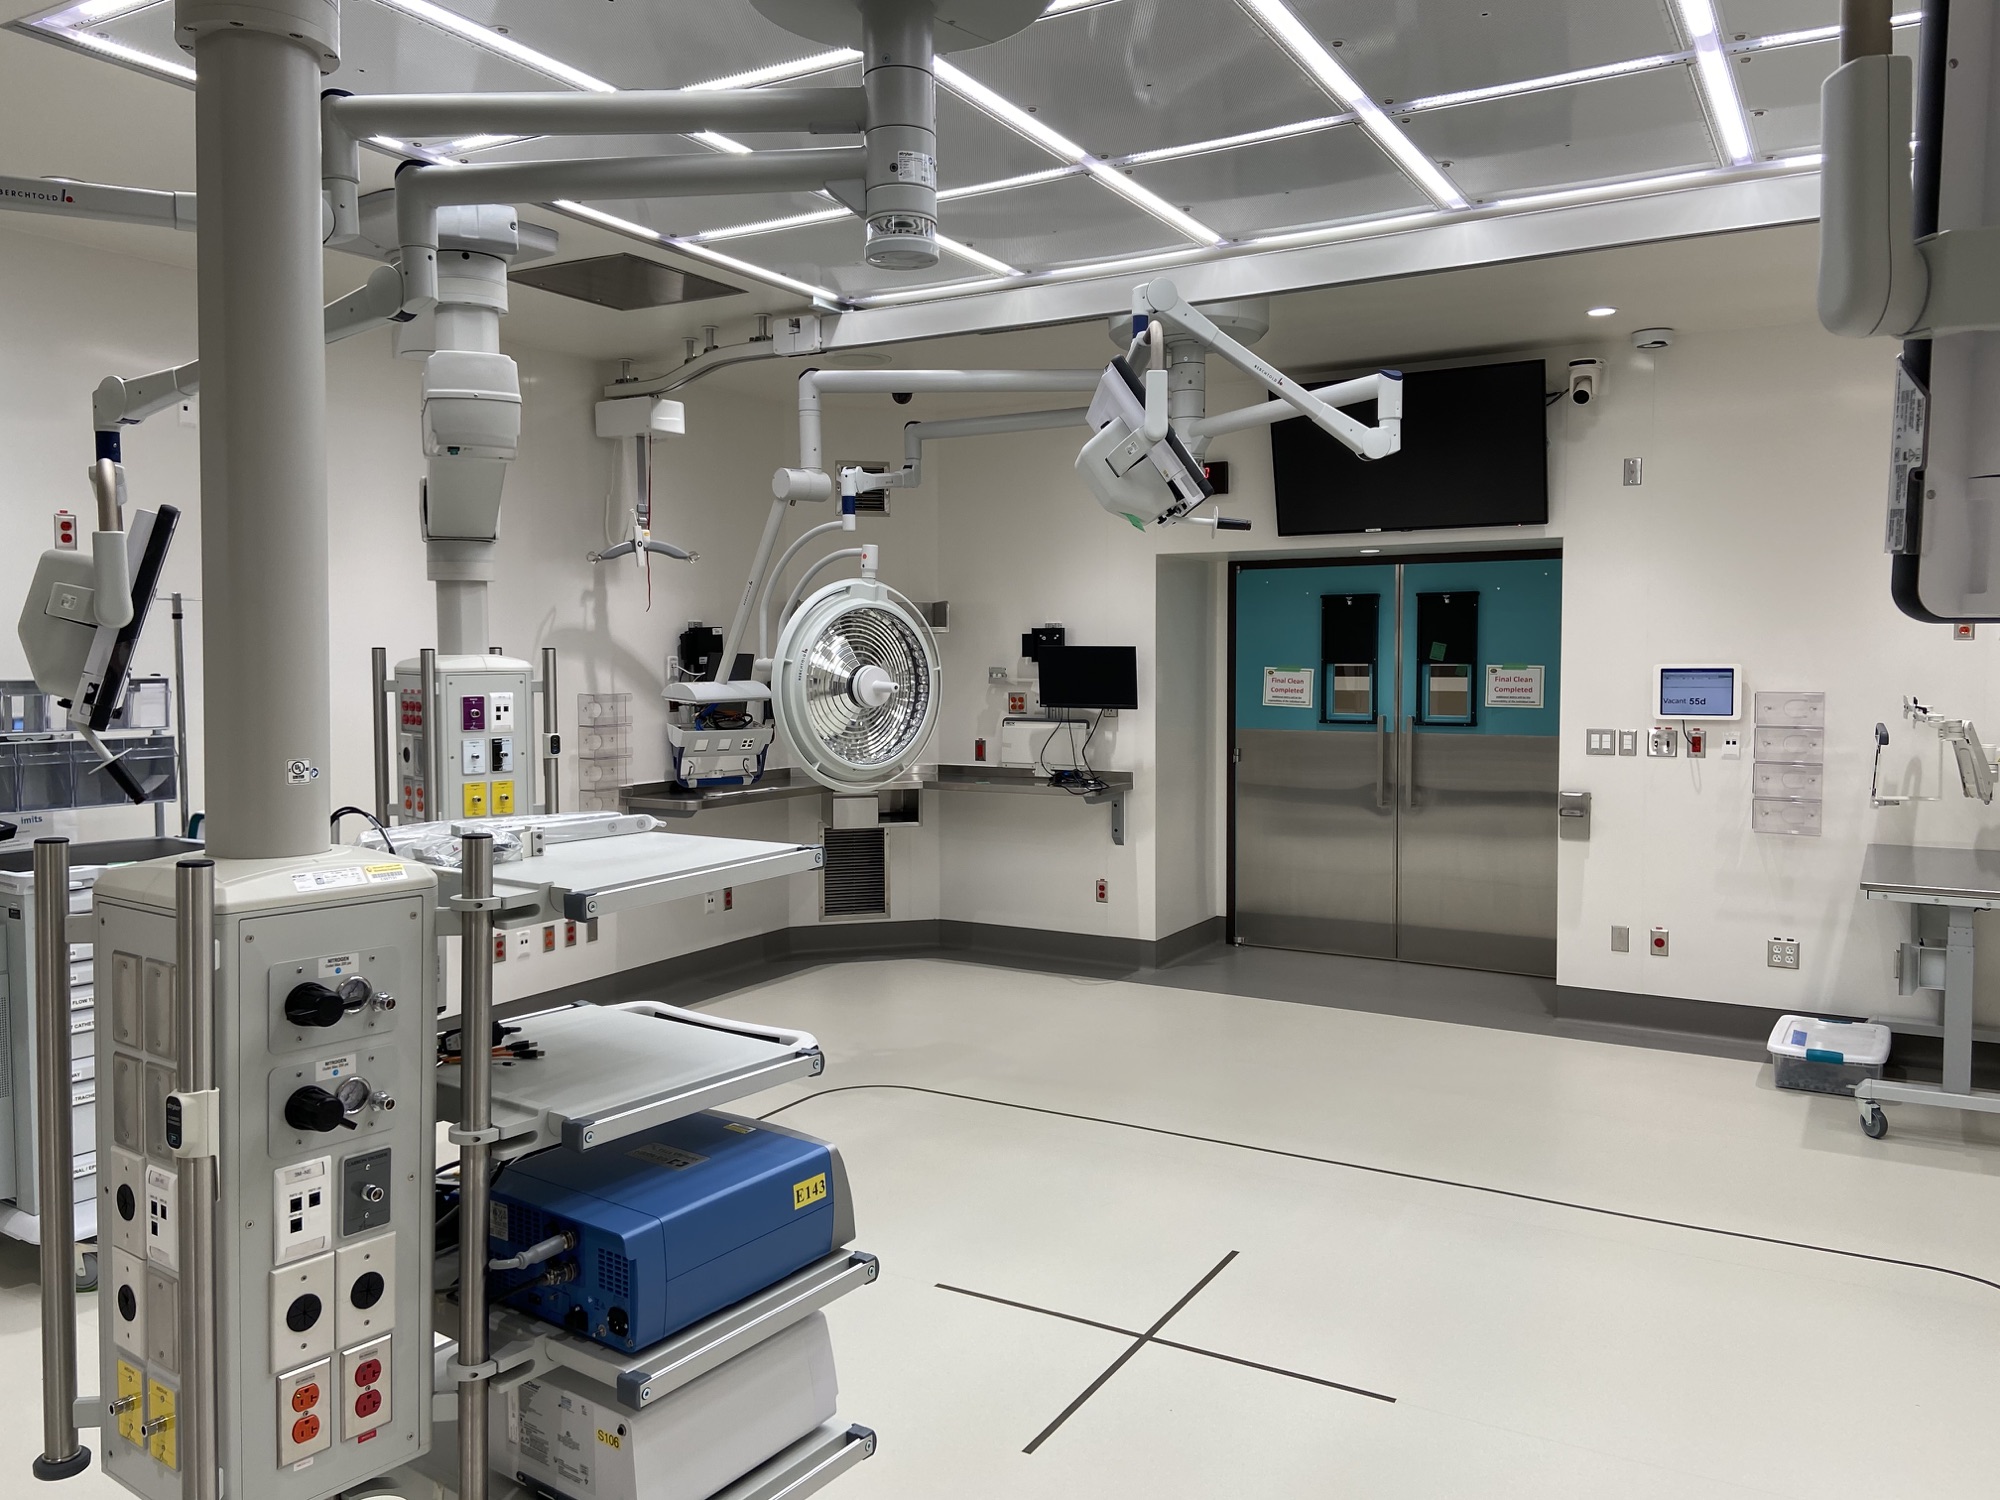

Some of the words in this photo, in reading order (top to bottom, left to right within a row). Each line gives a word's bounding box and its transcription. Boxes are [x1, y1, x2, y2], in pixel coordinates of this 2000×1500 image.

[1287, 677, 1304, 685] Clean
[1270, 686, 1304, 694] Completed
[1494, 686, 1533, 694] Completed
[1689, 697, 1706, 705] 55d
[325, 1058, 346, 1066] NITROGEN
[795, 1179, 826, 1204] E143
[597, 1429, 620, 1449] S106
